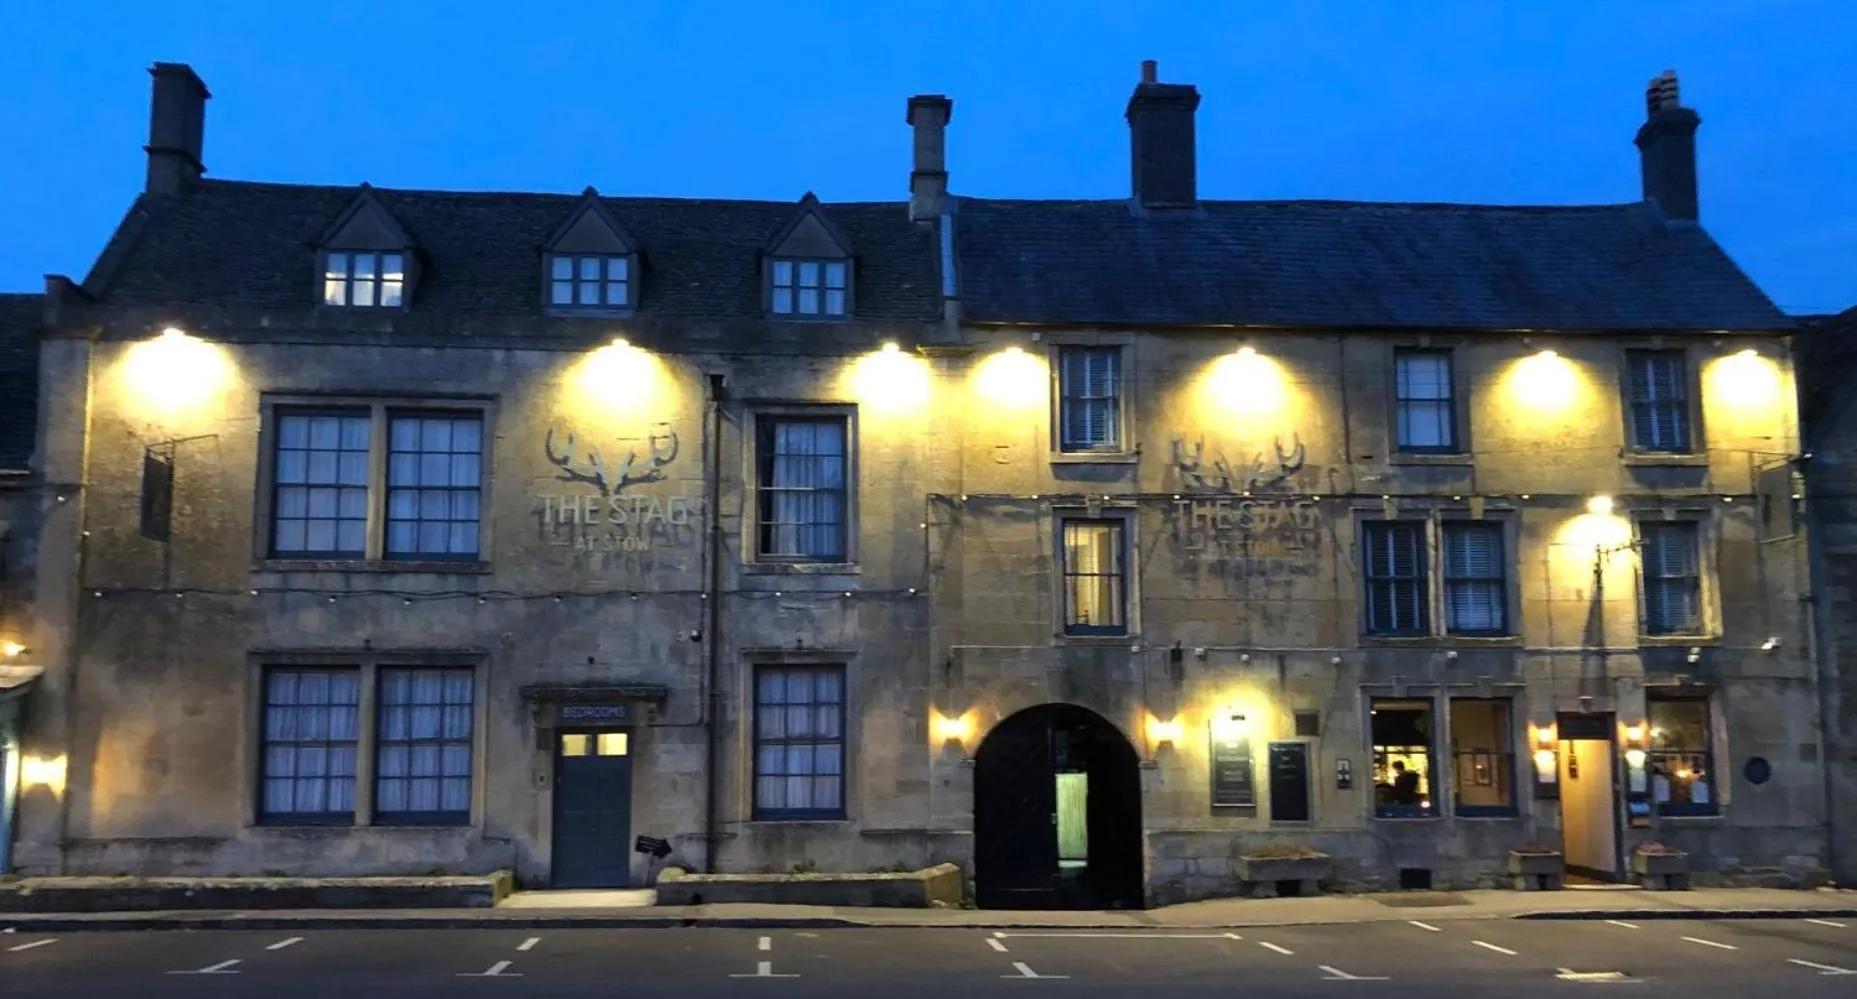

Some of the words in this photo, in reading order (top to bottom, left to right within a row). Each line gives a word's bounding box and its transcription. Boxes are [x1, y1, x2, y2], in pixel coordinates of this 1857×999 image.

[536, 494, 600, 525] THE
[607, 494, 689, 525] STAG
[1172, 500, 1233, 529] THE
[1239, 500, 1315, 530] STAG
[574, 537, 595, 551] AT
[602, 537, 650, 552] STOW
[563, 706, 626, 718] BEDROOMS
